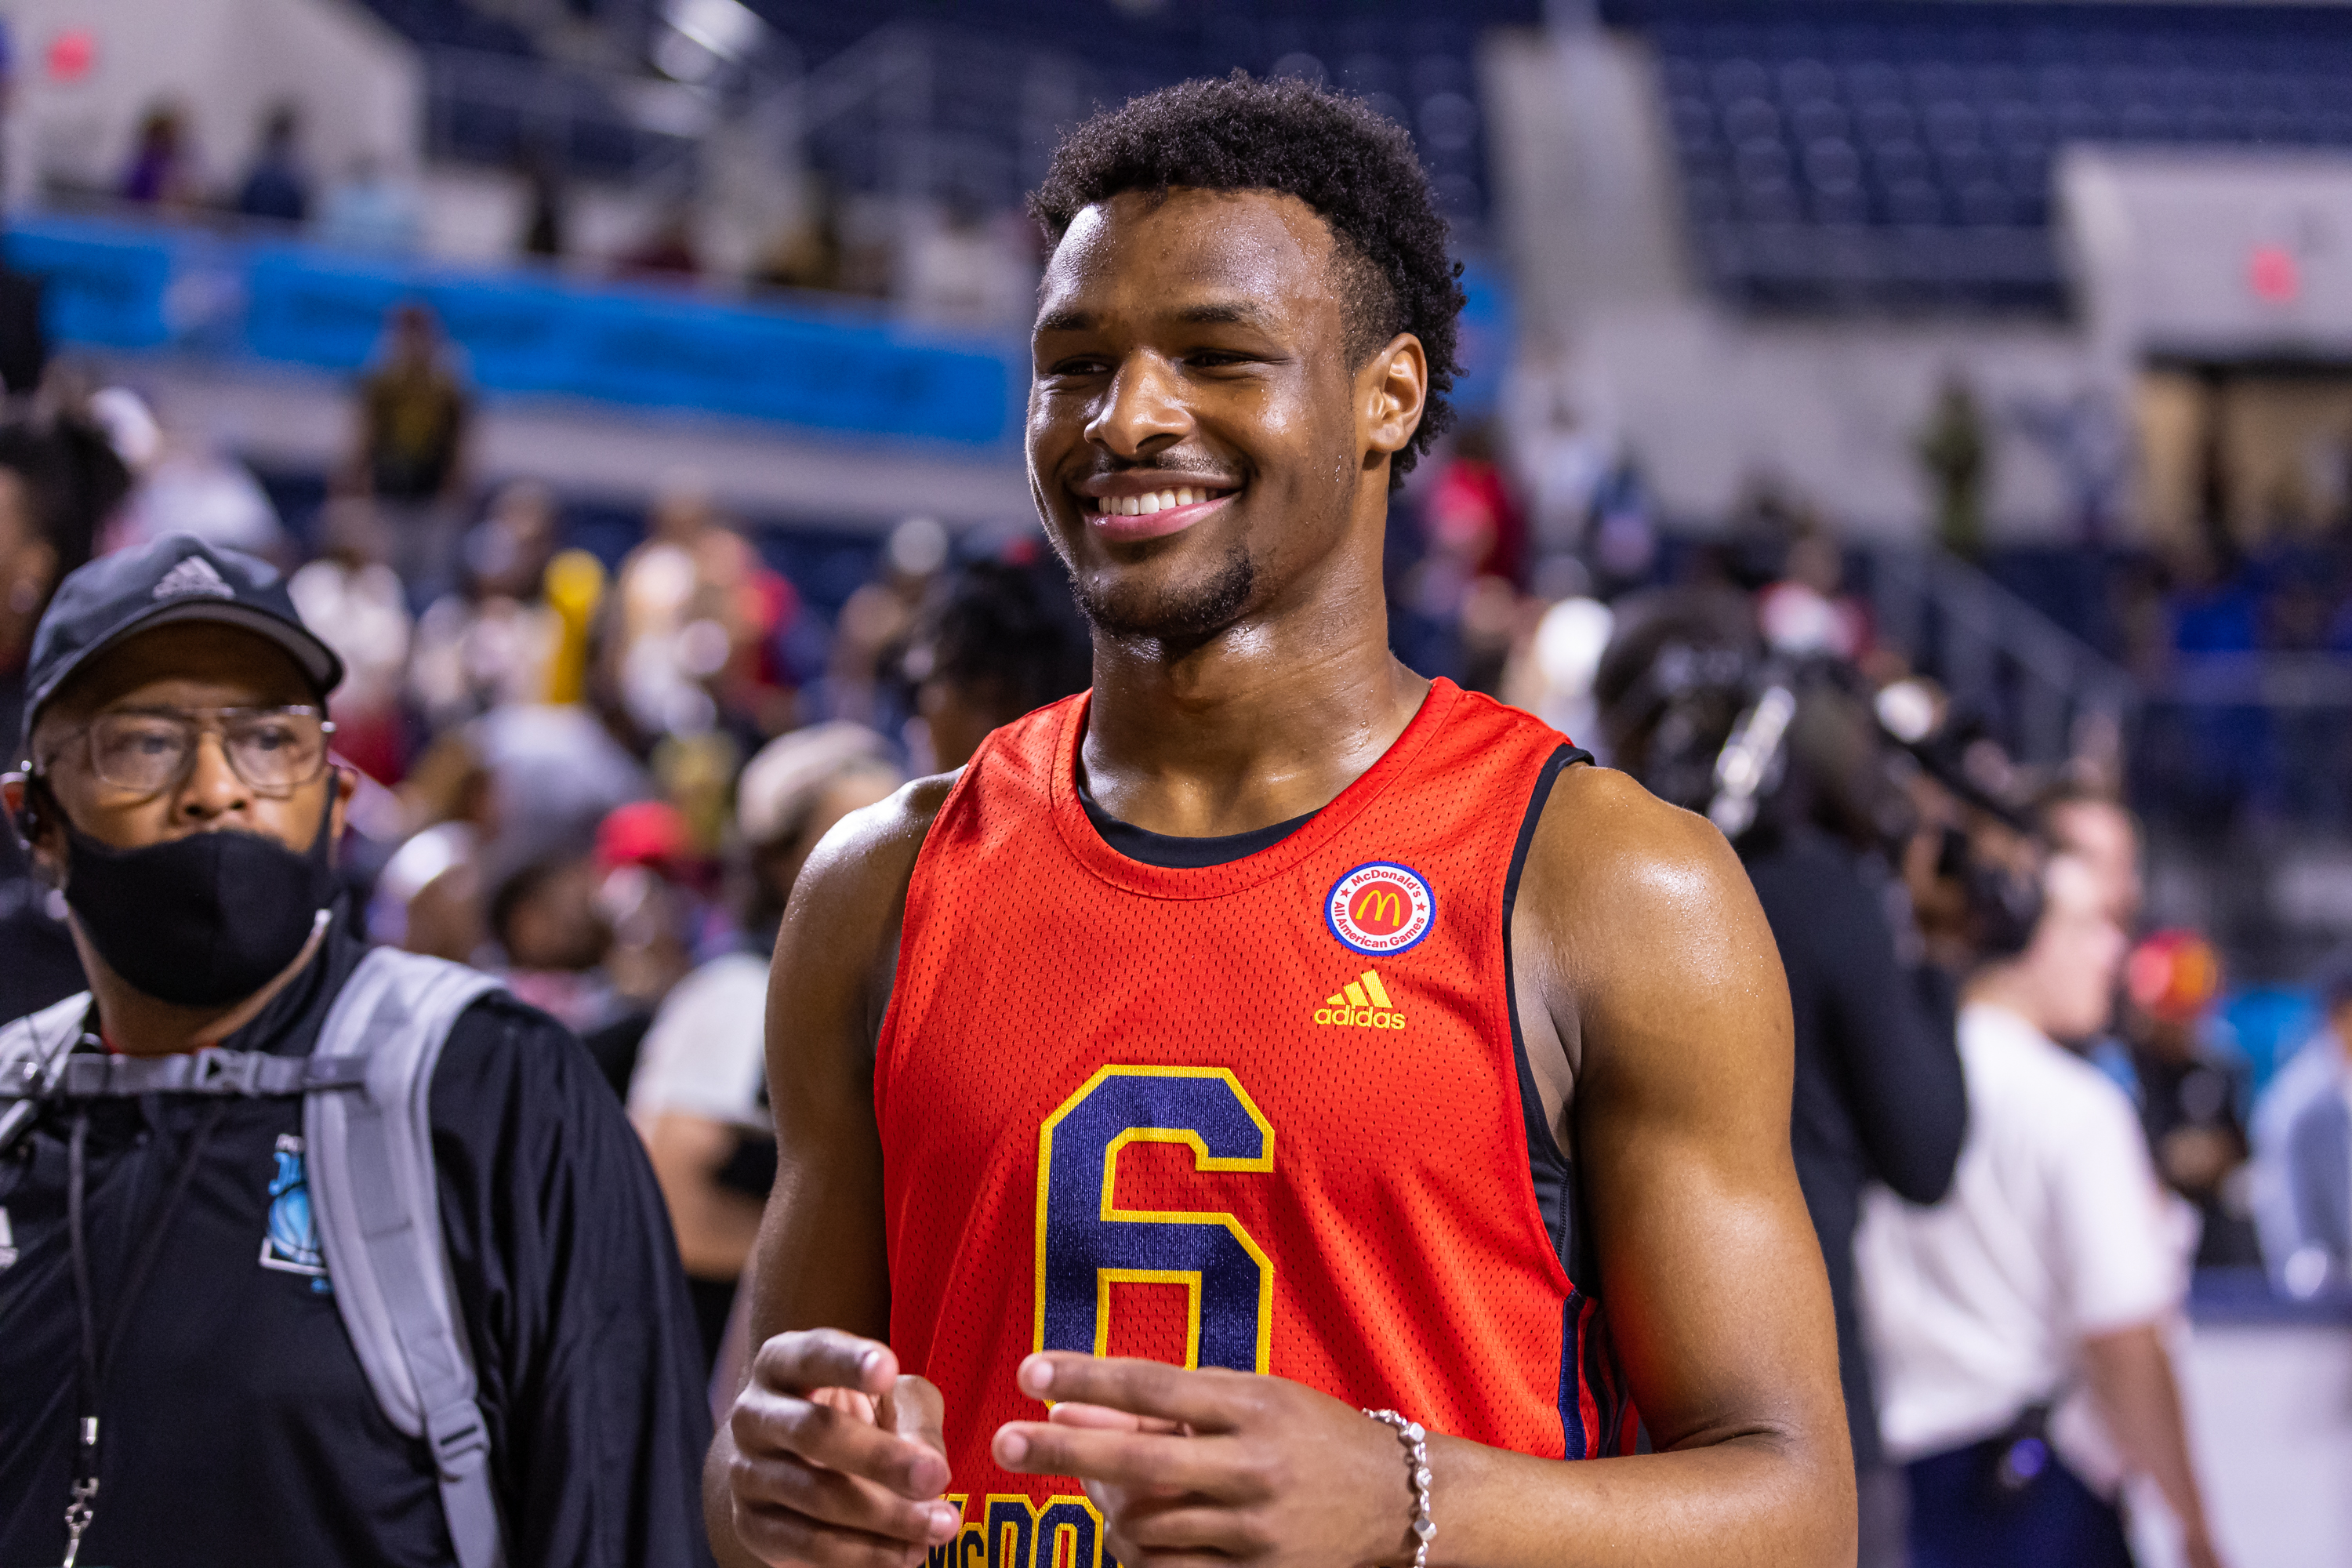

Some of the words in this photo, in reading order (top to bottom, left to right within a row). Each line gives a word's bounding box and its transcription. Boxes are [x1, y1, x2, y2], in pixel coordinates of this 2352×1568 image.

[1351, 869, 1421, 898] McDonald's
[1334, 901, 1346, 916] All
[1336, 918, 1388, 948] American
[1389, 916, 1425, 946] Games
[1314, 1004, 1406, 1030] adidas
[1033, 1064, 1276, 1411] 6
